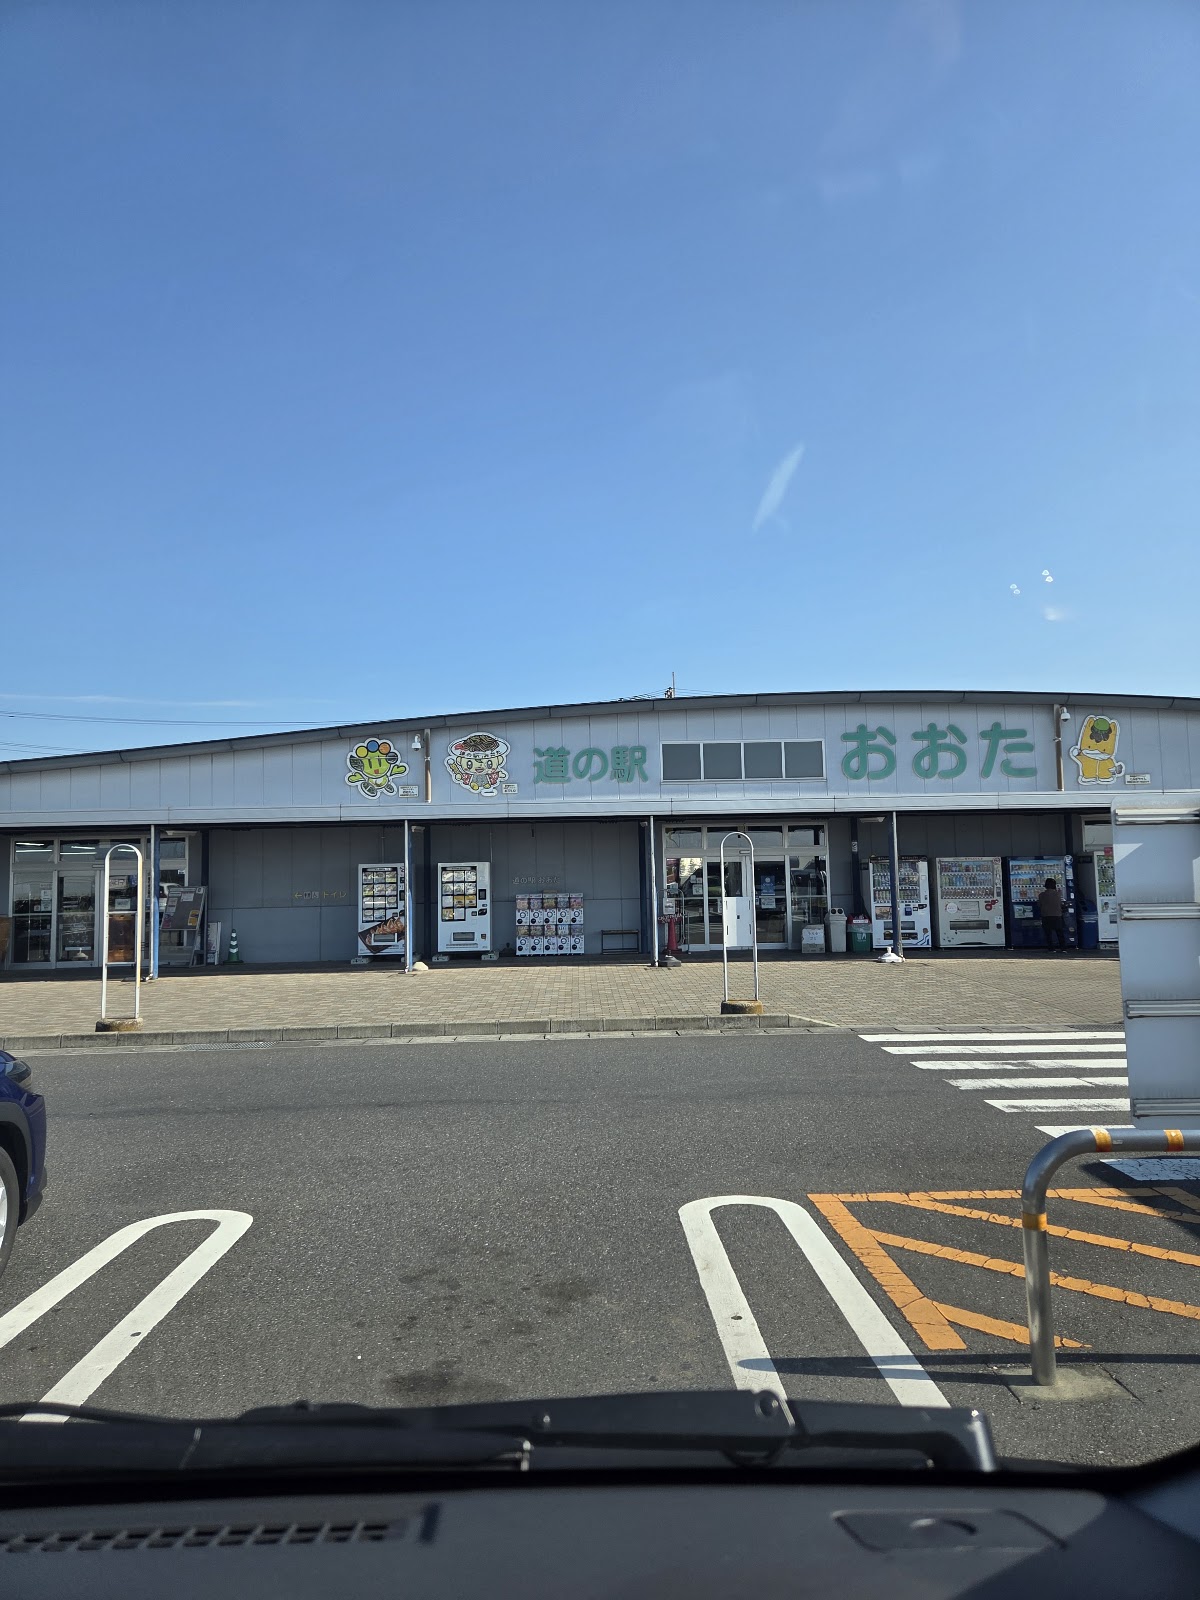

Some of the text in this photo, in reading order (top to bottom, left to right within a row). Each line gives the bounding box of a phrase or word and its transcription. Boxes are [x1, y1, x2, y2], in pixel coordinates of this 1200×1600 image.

[533, 721, 1037, 784] 道の駅 おおた
[323, 891, 347, 899] トイレ
